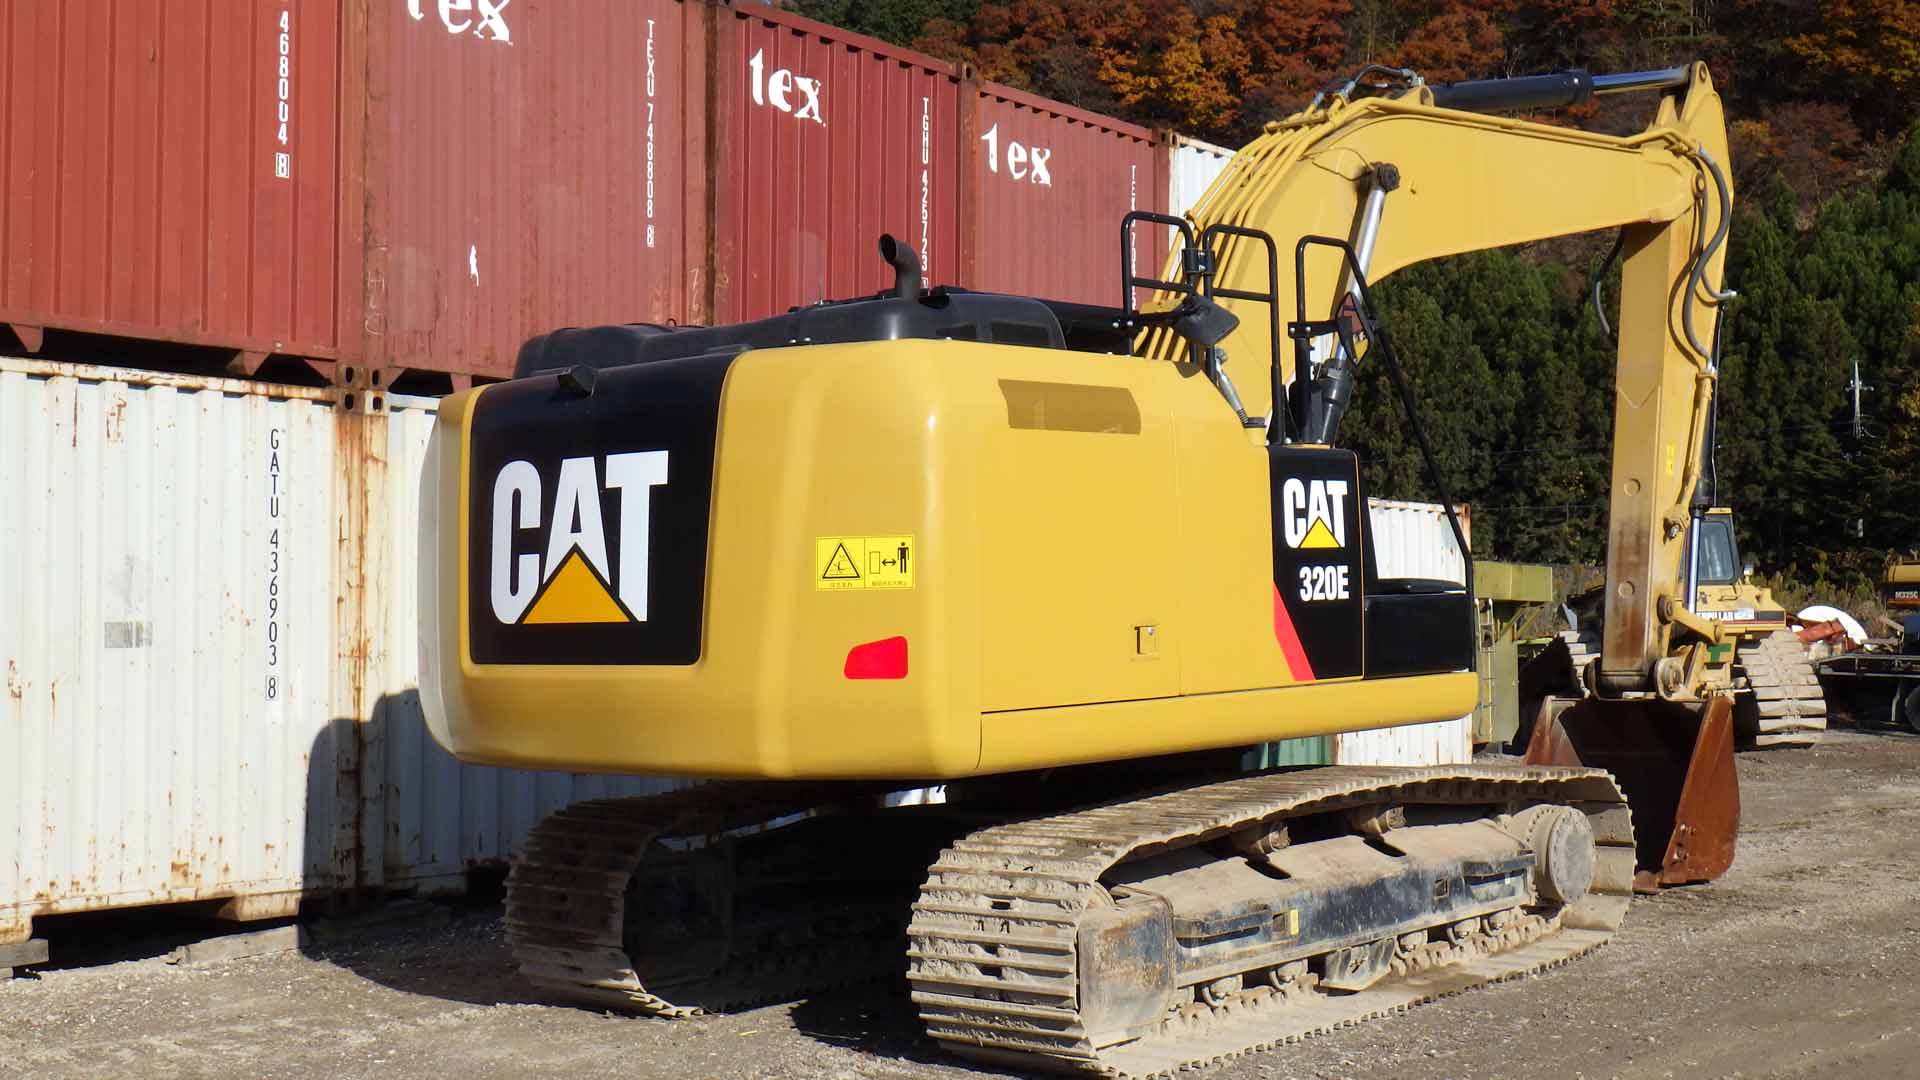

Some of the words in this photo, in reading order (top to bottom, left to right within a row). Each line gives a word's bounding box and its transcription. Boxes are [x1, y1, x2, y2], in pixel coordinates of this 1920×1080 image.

[277, 10, 289, 145] 468004
[646, 19, 655, 97] TEXU
[276, 153, 290, 178] 8
[646, 102, 654, 218] 748808
[270, 428, 279, 518] GATU
[1283, 478, 1348, 549] CAT
[491, 450, 669, 625] CAT
[269, 528, 279, 666] 436903
[1300, 565, 1349, 602] 320E
[266, 676, 279, 700] 8
